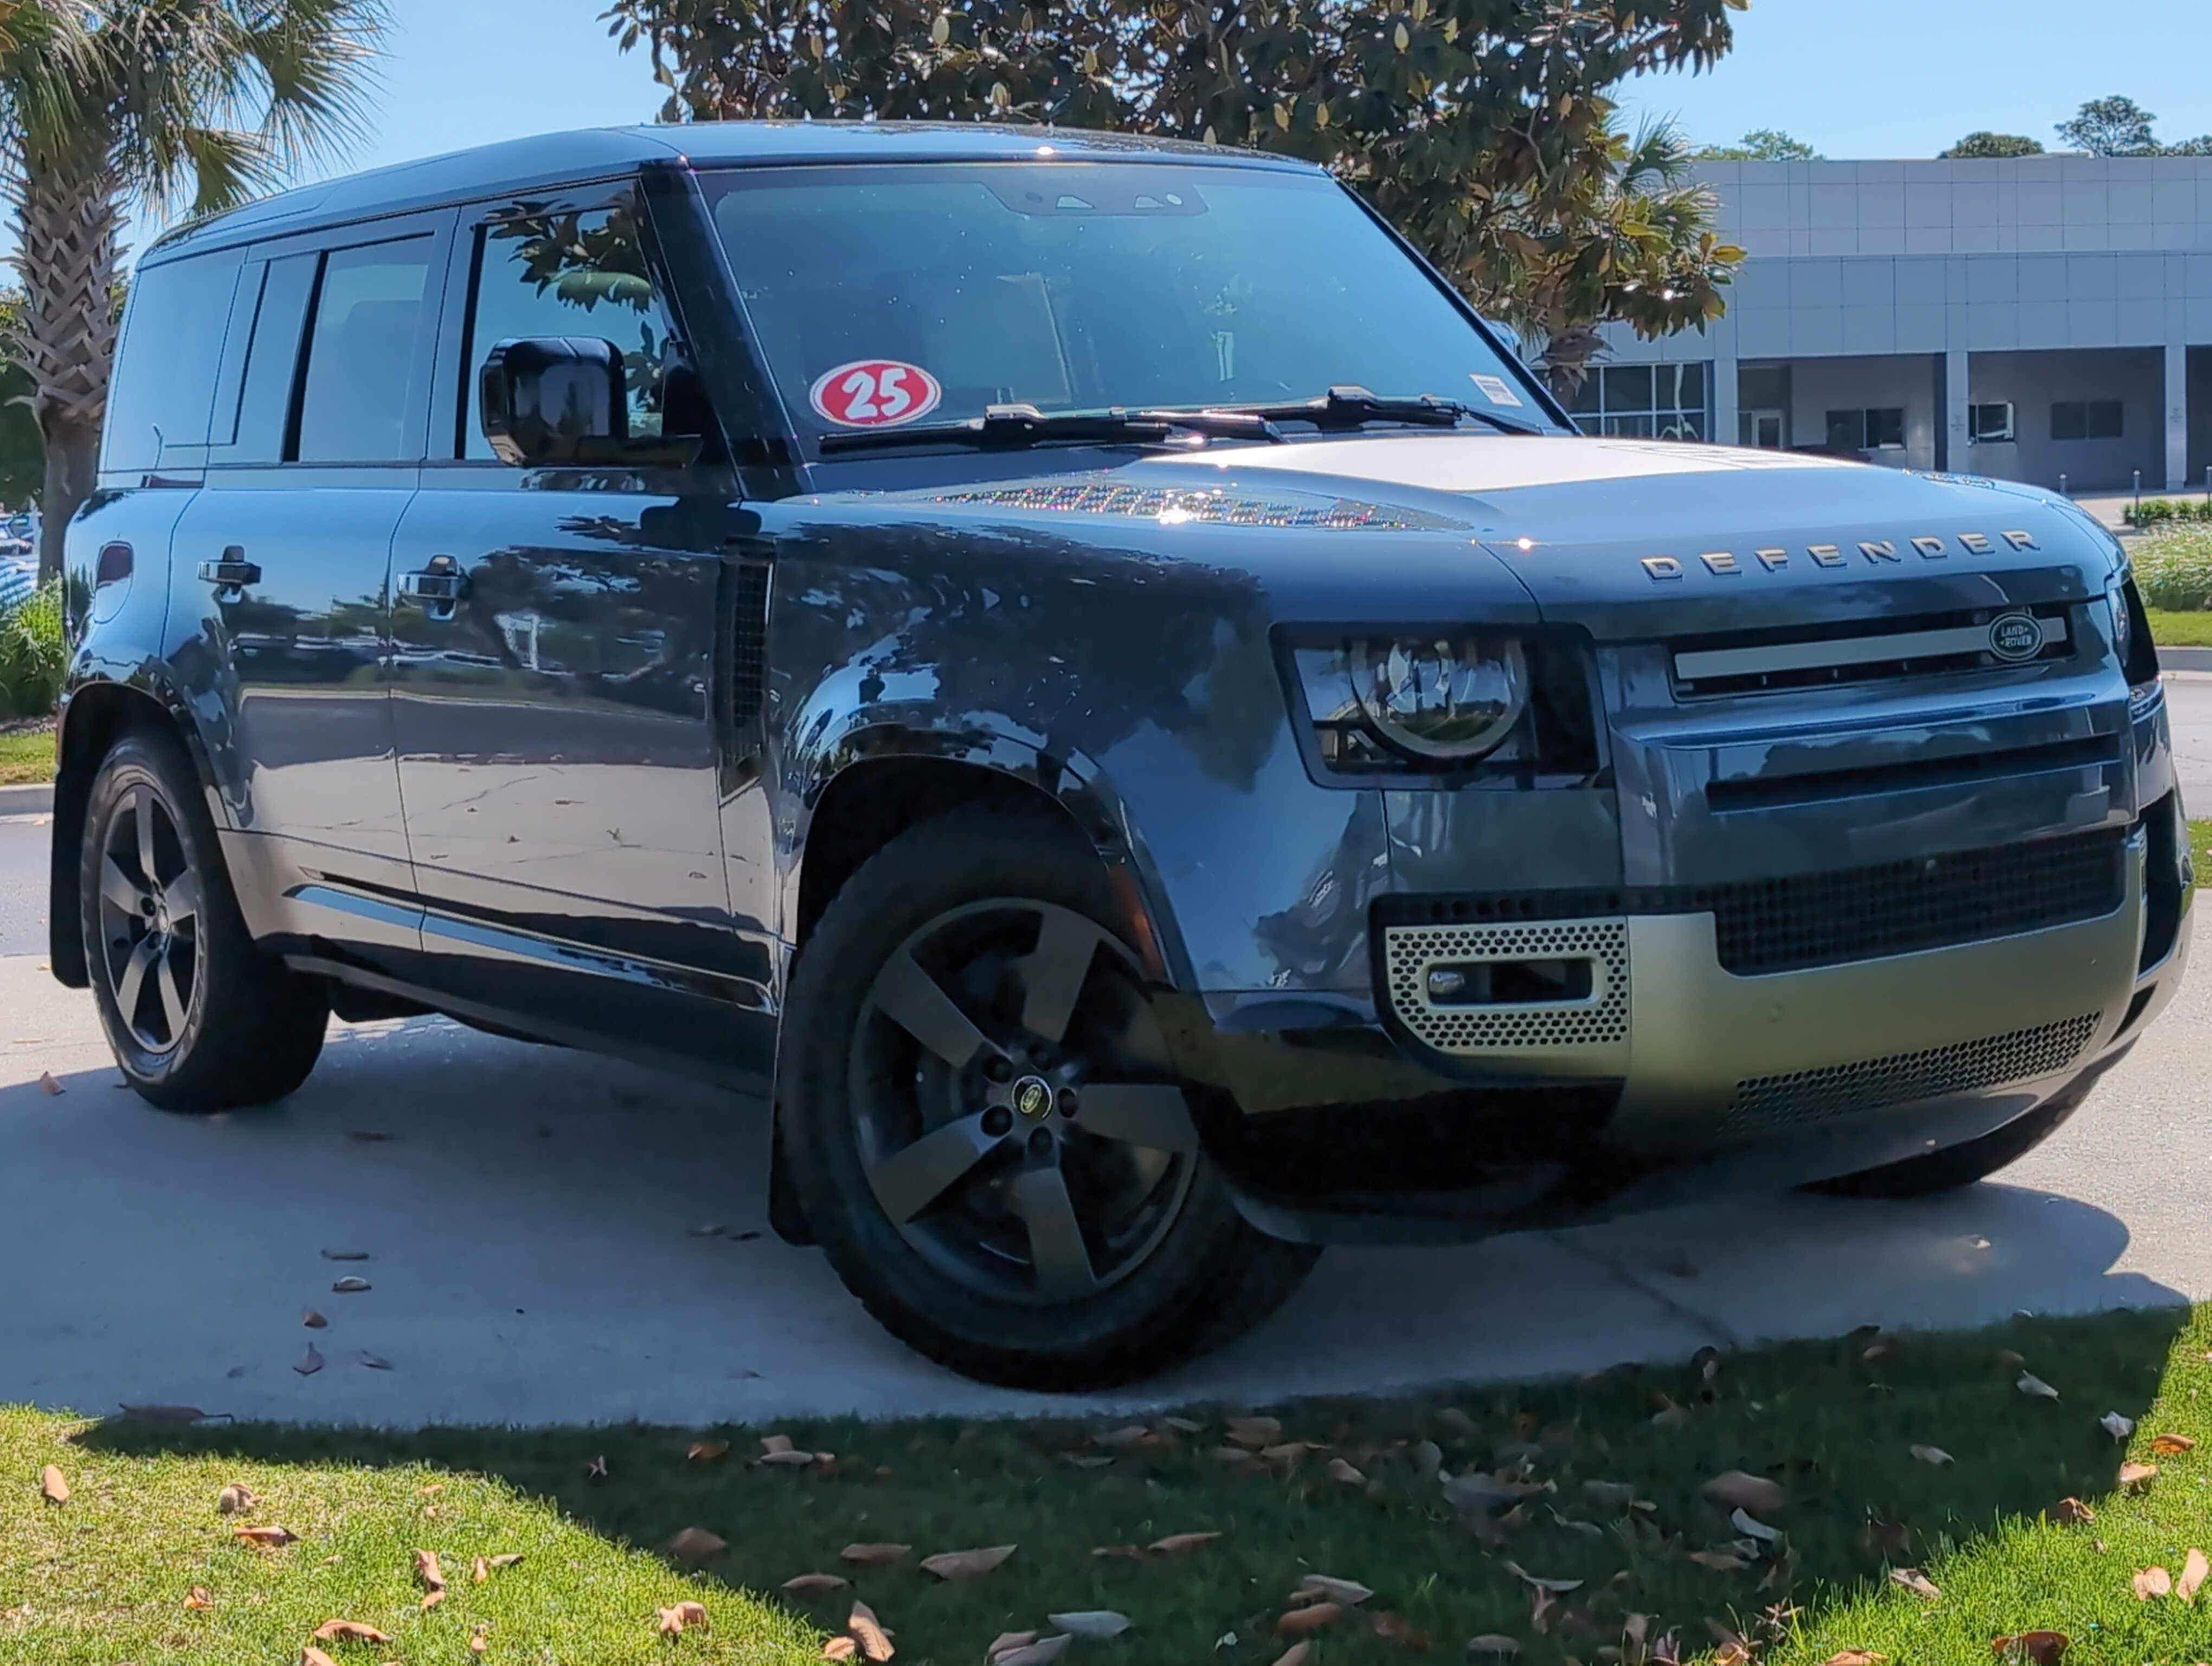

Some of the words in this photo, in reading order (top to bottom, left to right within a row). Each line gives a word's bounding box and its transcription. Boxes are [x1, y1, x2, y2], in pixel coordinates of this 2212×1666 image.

[842, 368, 911, 419] 25
[1640, 529, 2041, 580] DEFENDER
[2001, 625, 2024, 636] LAND
